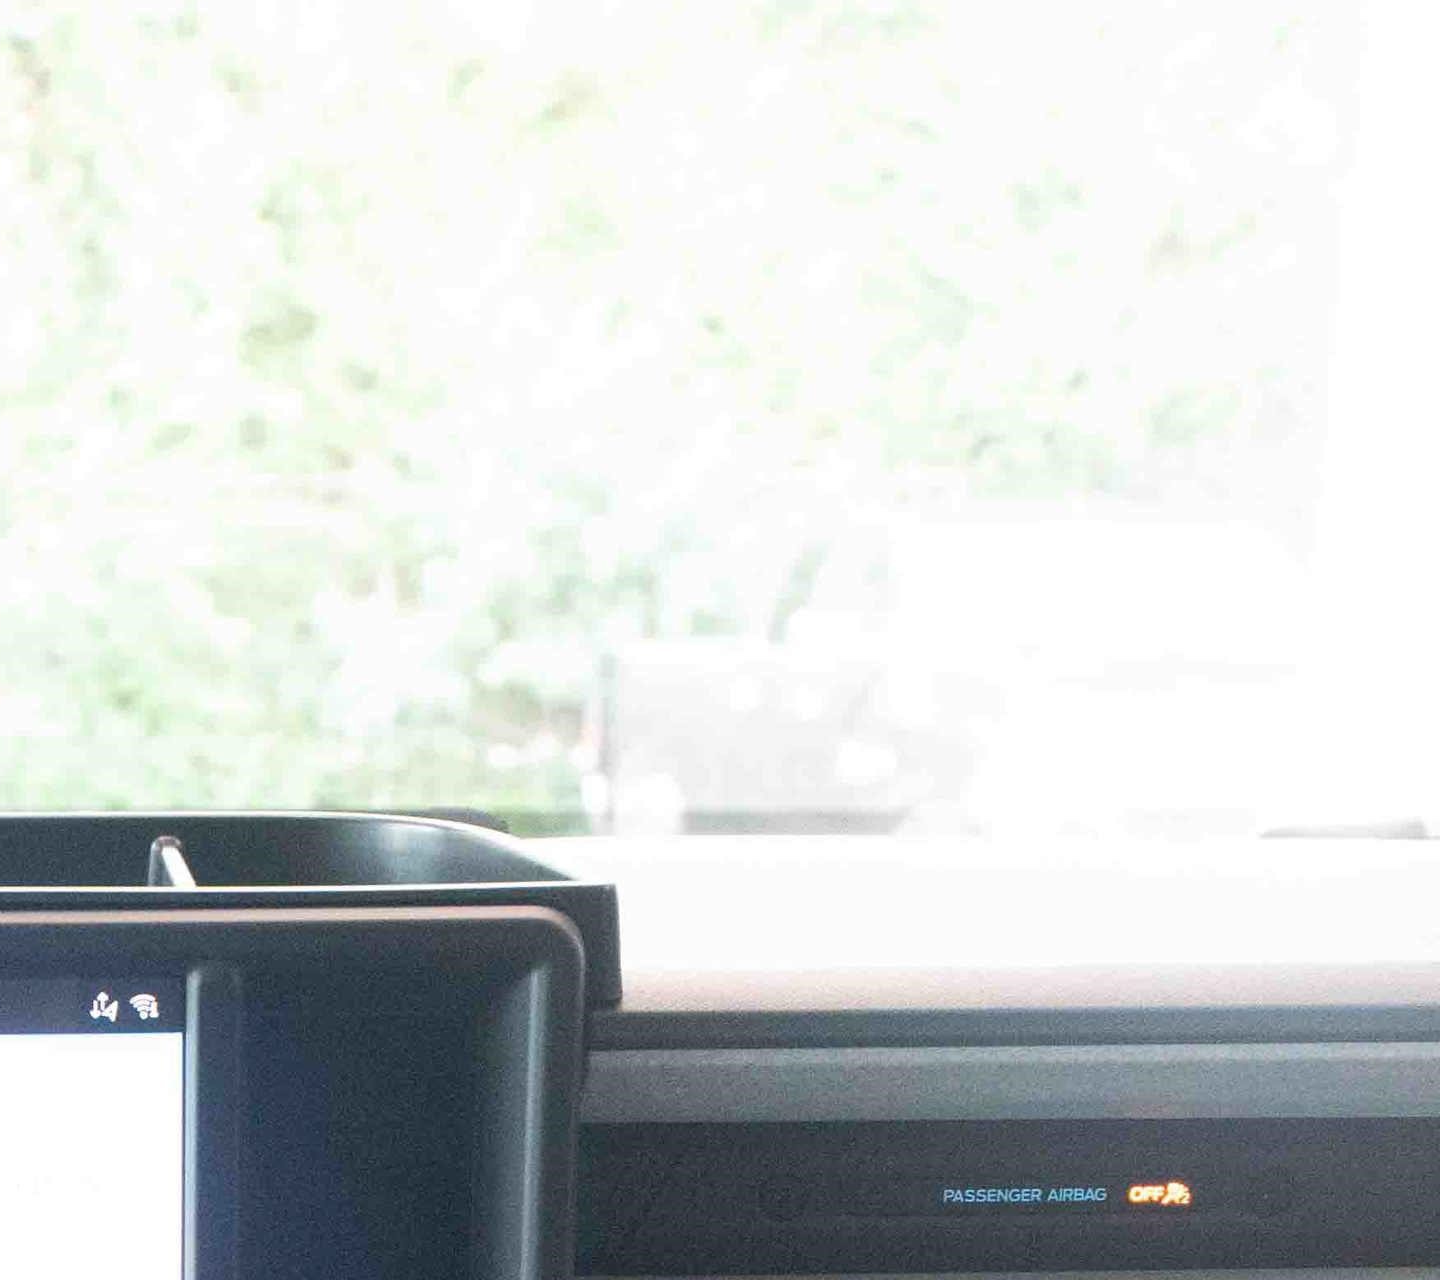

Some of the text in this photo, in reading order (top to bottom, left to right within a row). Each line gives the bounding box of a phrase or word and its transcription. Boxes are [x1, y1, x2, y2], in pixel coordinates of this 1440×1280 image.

[942, 1187, 1108, 1203] PASSENGER AIRBAG
[1128, 1184, 1165, 1203] OFF
